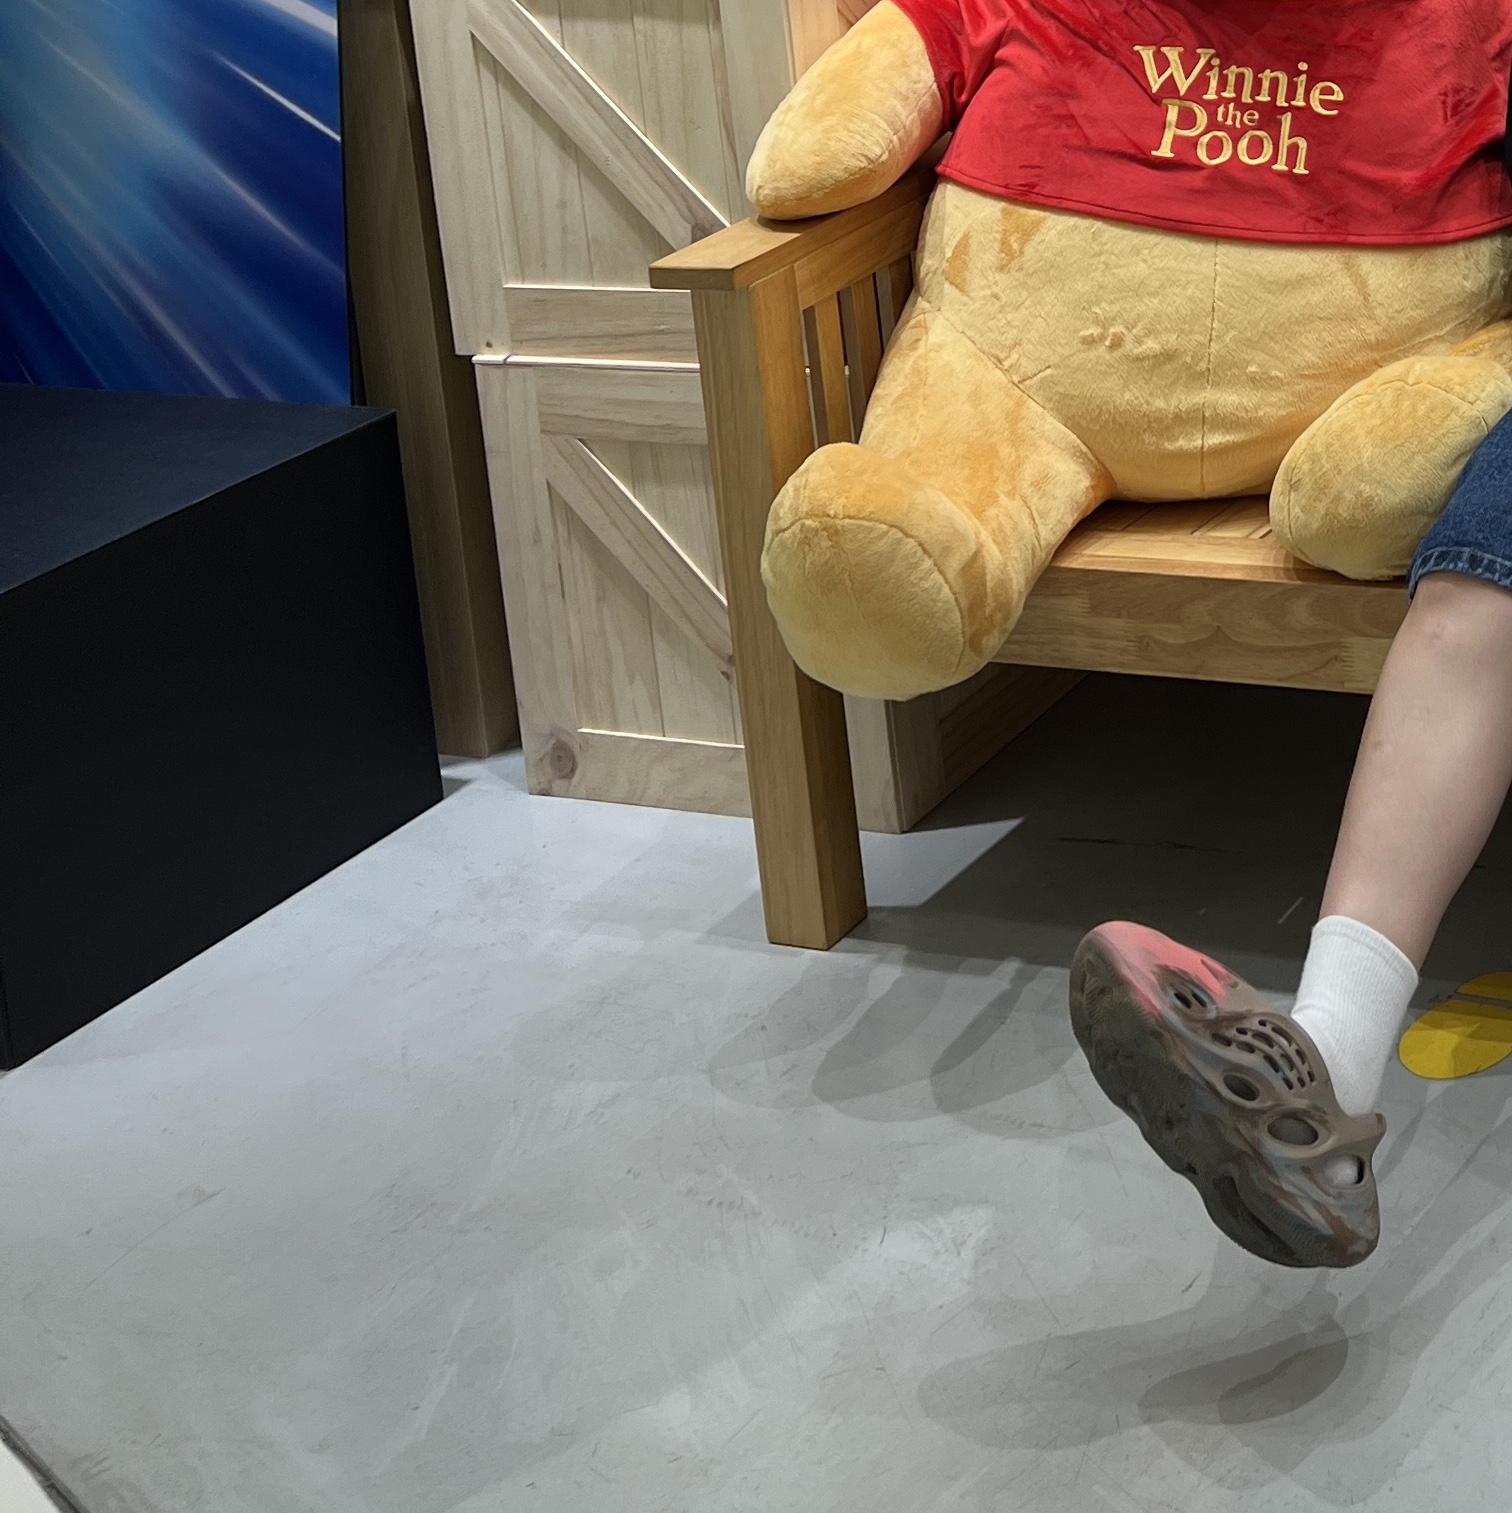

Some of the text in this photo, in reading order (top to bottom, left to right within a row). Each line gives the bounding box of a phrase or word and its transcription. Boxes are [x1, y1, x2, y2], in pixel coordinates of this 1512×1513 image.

[1133, 45, 1344, 115] Winnie
[1216, 102, 1260, 128] the
[1151, 98, 1309, 175] Pooh
